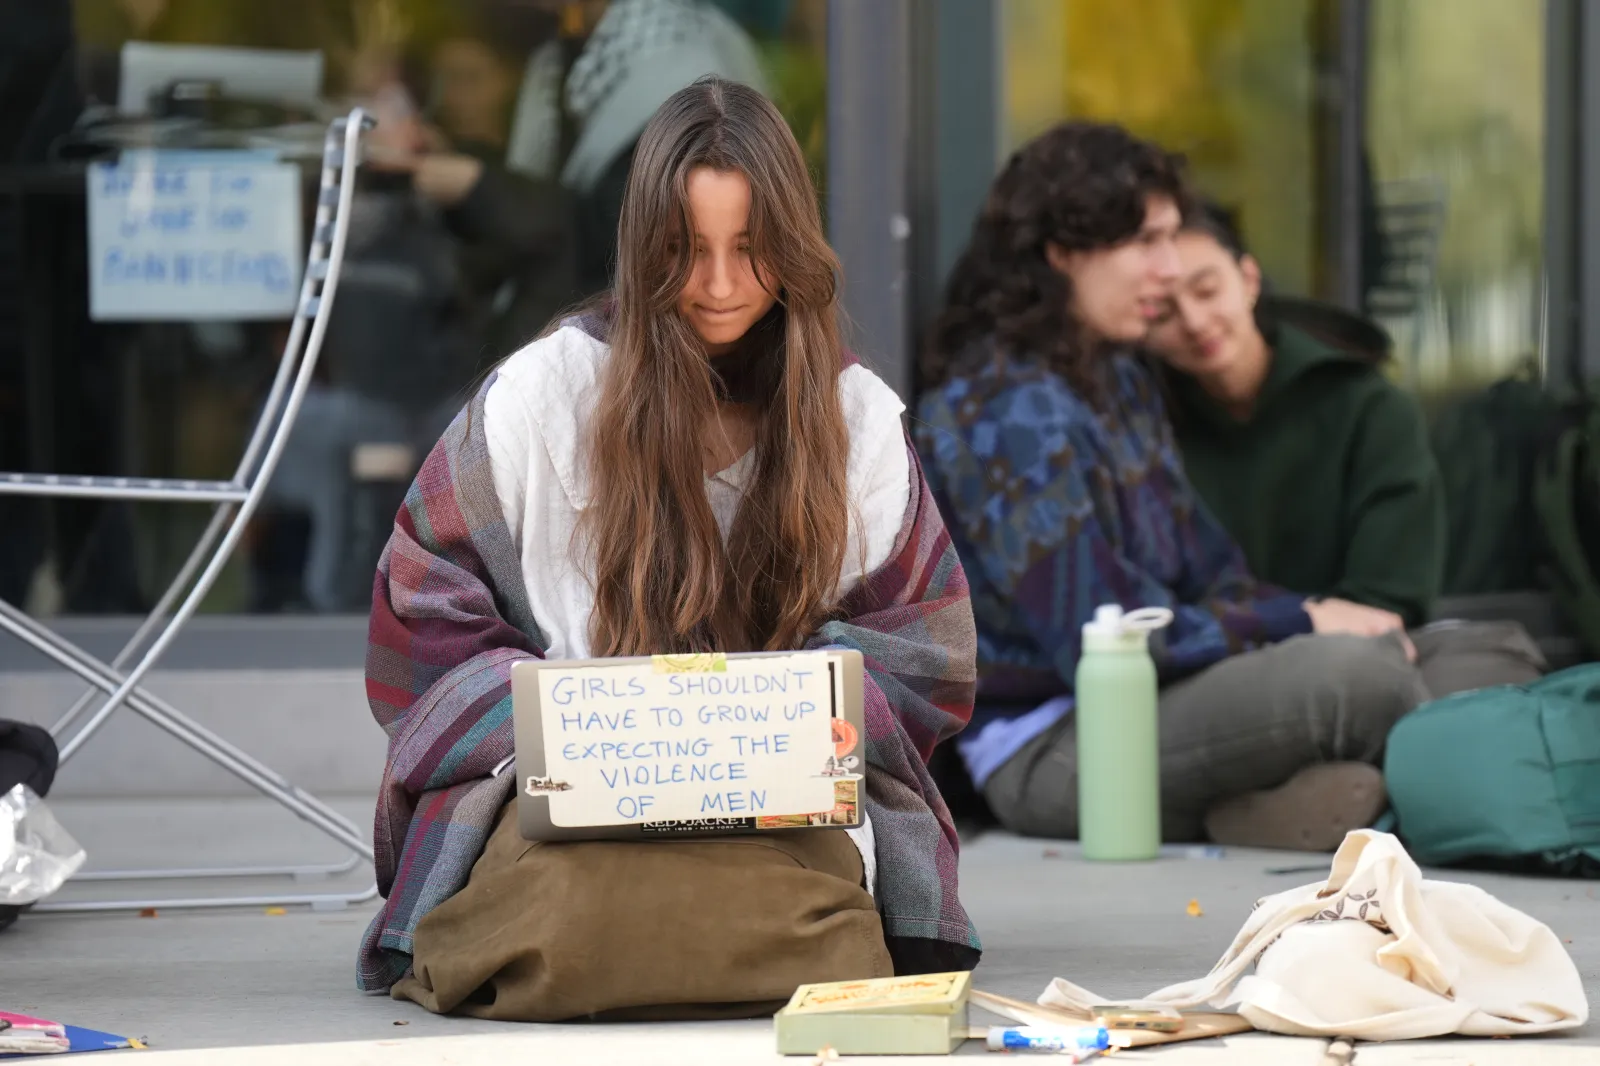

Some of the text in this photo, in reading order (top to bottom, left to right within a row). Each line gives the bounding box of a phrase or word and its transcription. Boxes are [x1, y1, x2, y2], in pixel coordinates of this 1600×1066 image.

[552, 668, 813, 706] GIRLS SHOULDN'T
[561, 701, 816, 732] HAVE TO GROW UP
[563, 734, 790, 761] EXPECTING THE
[600, 763, 748, 789] VIOLENCE
[616, 790, 767, 819] OF MEN
[643, 816, 747, 828] RED JACKET
